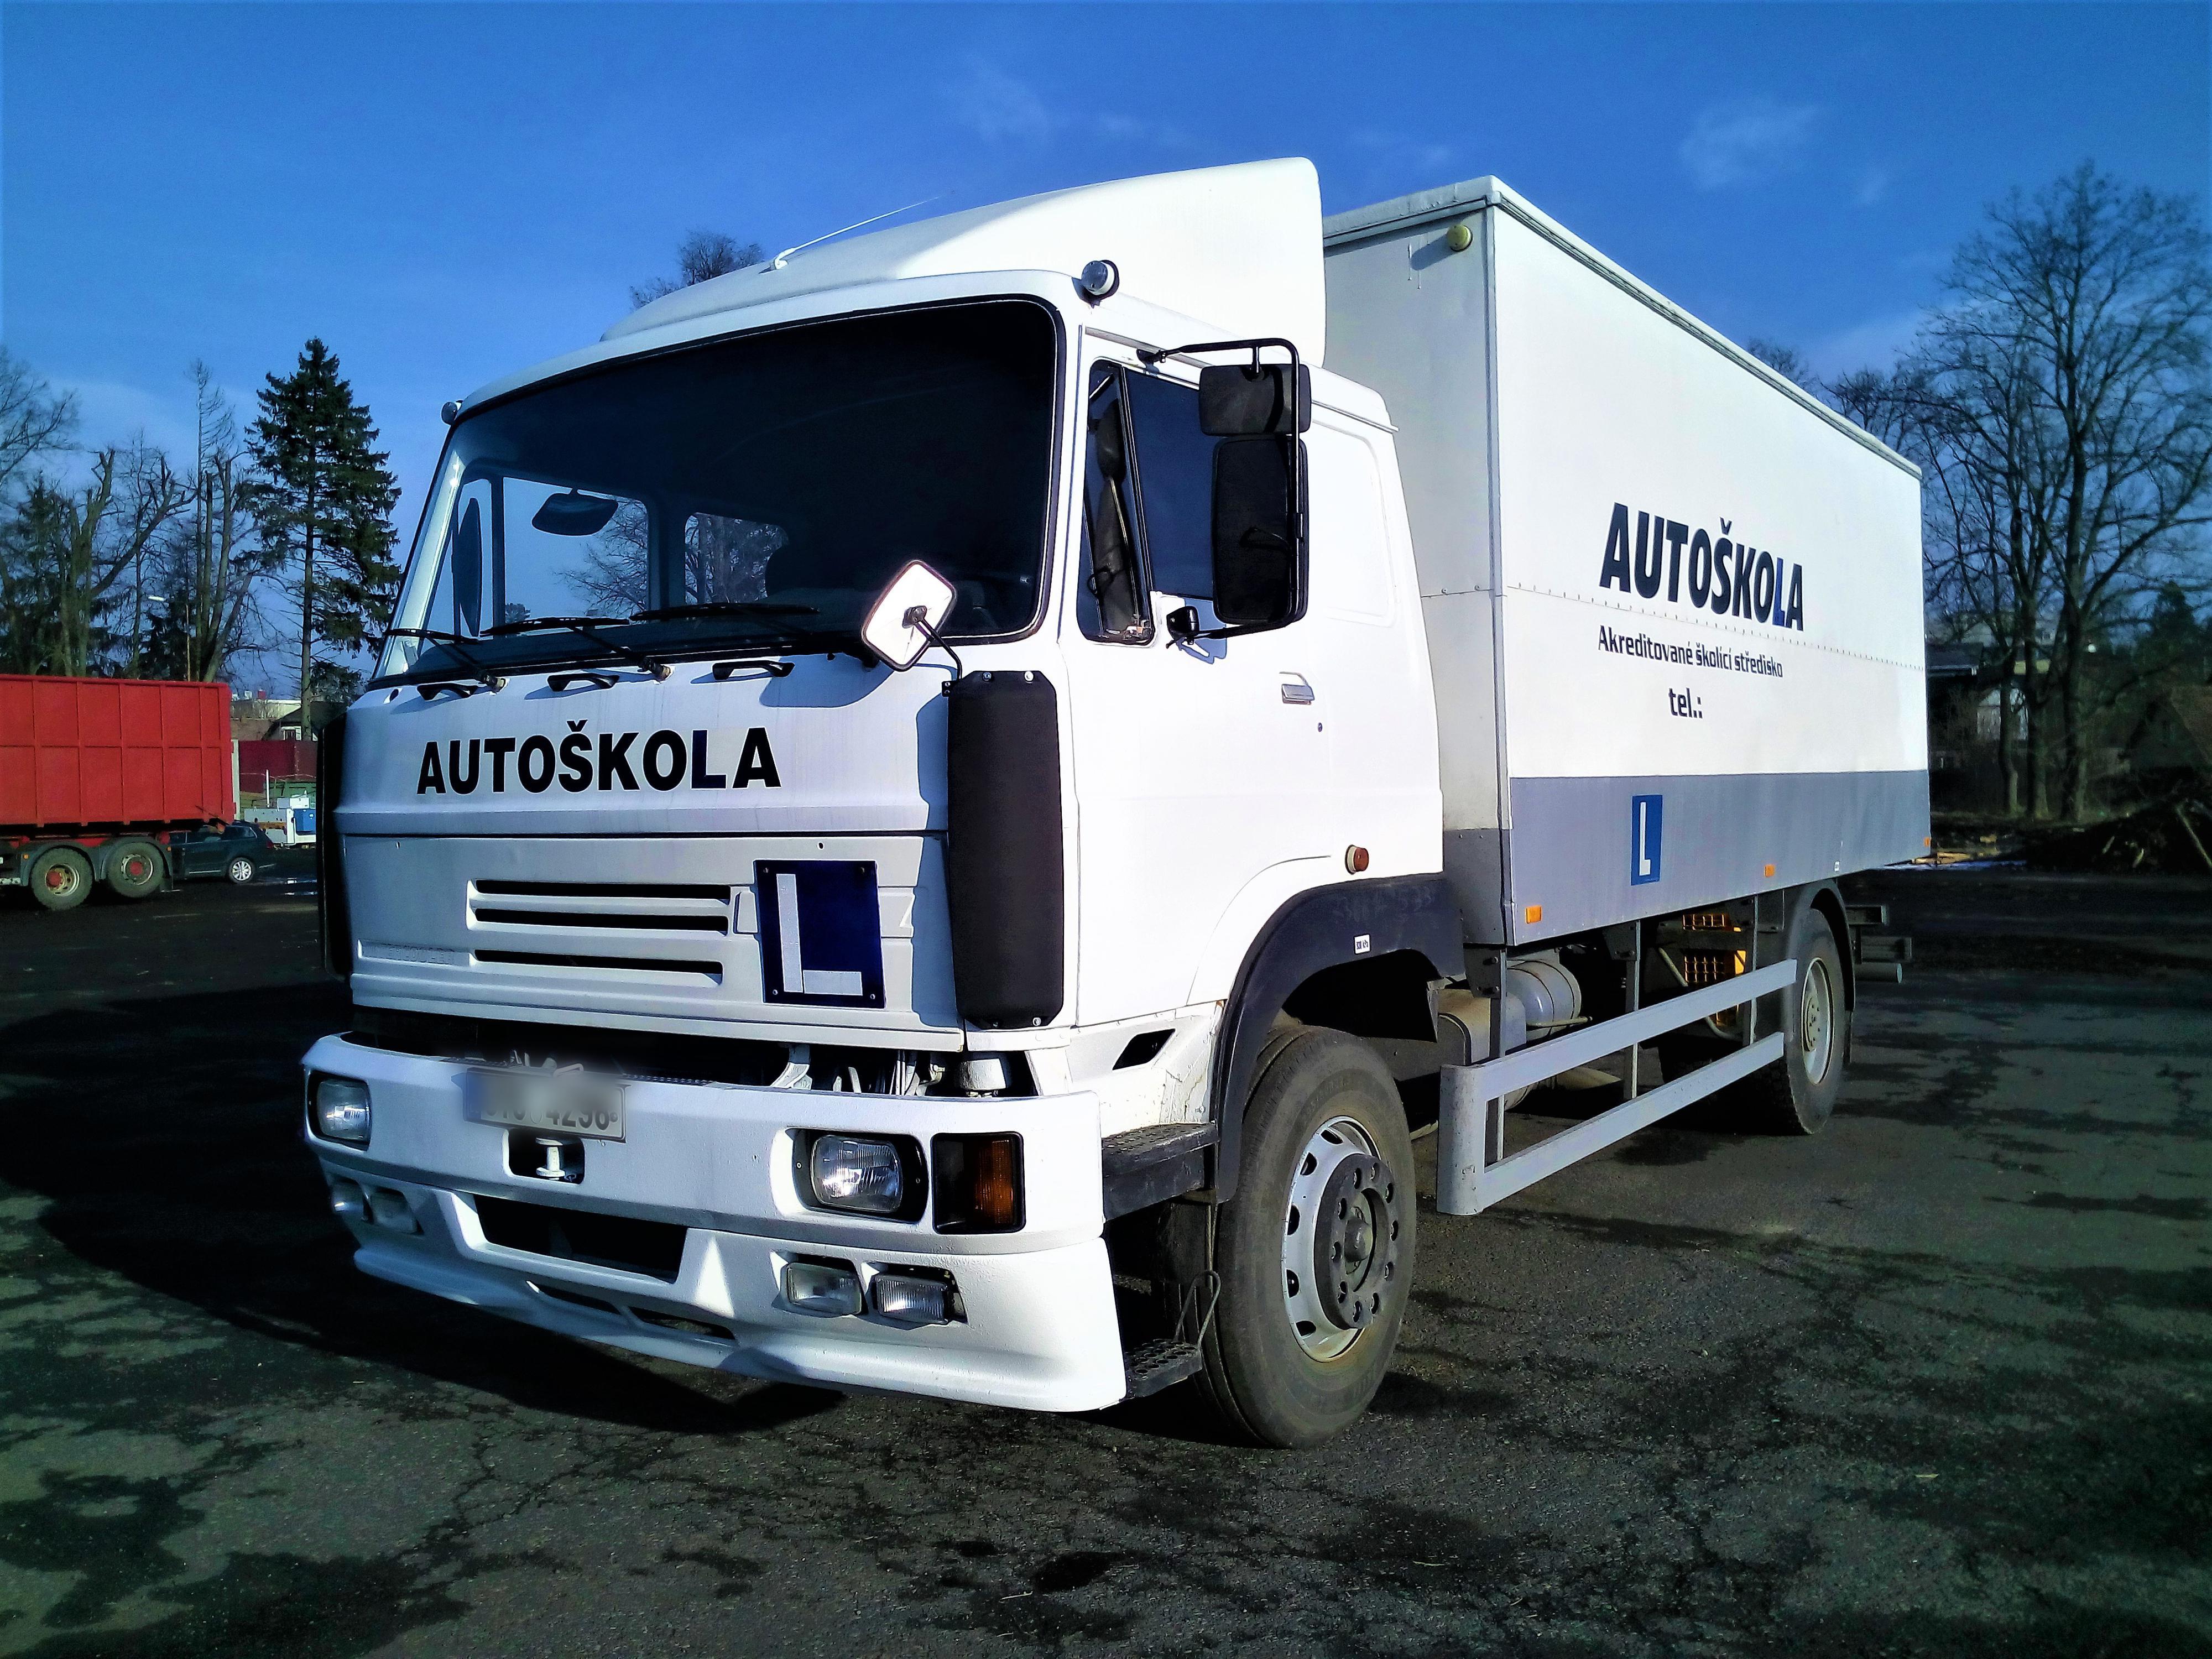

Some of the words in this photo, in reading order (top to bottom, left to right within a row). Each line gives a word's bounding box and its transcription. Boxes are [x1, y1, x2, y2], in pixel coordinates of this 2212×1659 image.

[1599, 502, 1804, 632] AUTOŠKOLA
[1598, 625, 1693, 665] Akreditované
[1695, 642, 1733, 671] školící
[1734, 650, 1783, 678] středisko
[1668, 687, 1703, 719] tel.:
[416, 719, 782, 795] AUTOŠKOLA
[1639, 801, 1651, 877] L
[776, 873, 863, 996] L
